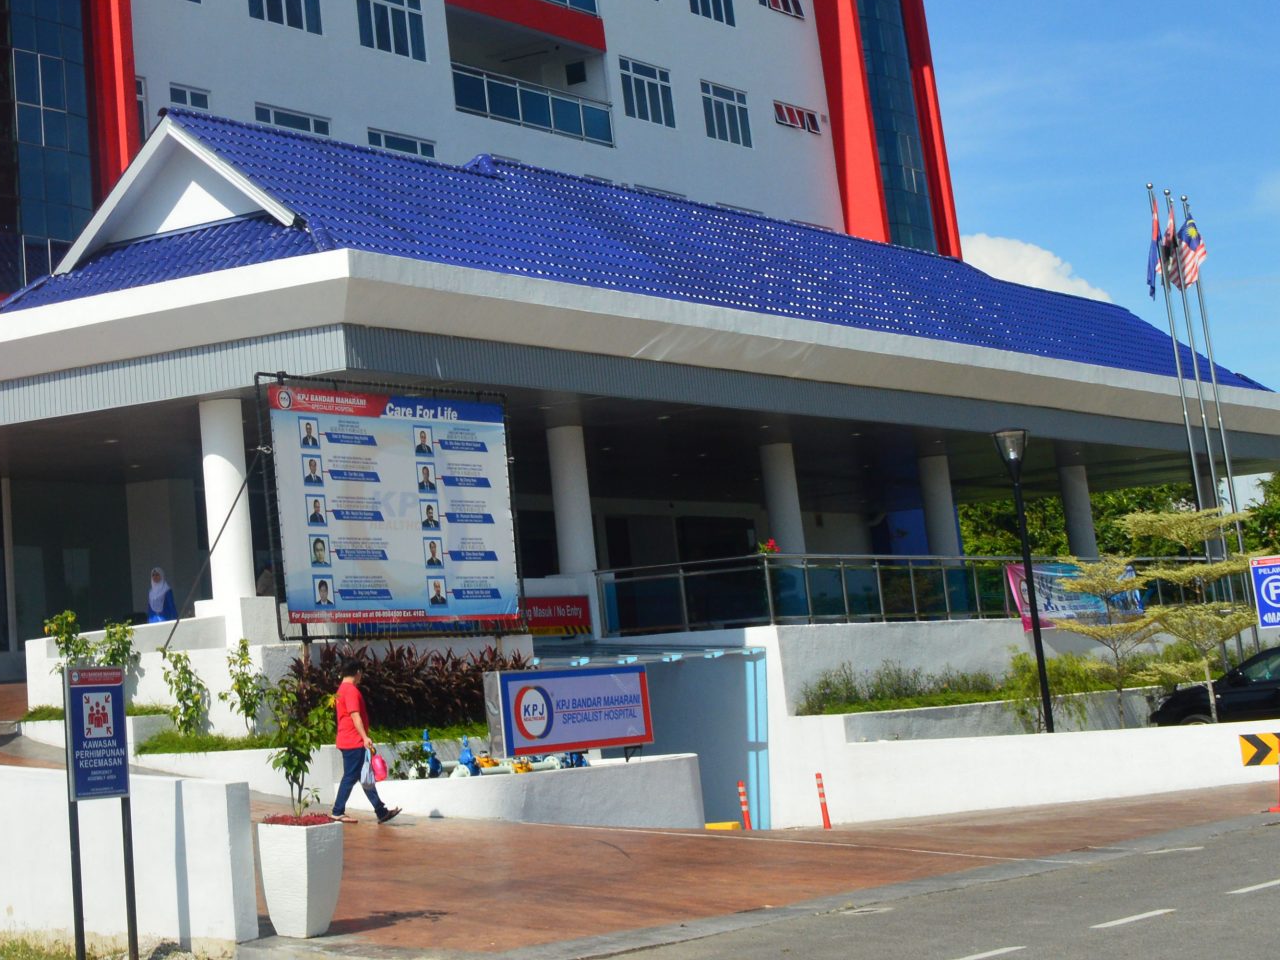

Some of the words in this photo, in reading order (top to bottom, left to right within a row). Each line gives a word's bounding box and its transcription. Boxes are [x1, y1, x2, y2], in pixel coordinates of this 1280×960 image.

[297, 393, 308, 401] KPJ
[310, 394, 336, 403] BANDAR
[336, 397, 367, 406] MAHARANI
[311, 403, 334, 411] SPECIALIST
[385, 402, 414, 418] Care
[416, 404, 435, 419] For
[437, 406, 458, 421] Life
[556, 699, 570, 710] KPJ
[571, 696, 602, 709] BANDAR
[603, 693, 641, 707] MAHARANI
[523, 703, 545, 717] KPJ
[562, 711, 602, 724] SPECIALIST
[604, 708, 637, 720] HOSPITAL
[82, 740, 117, 749] KAWASAN
[75, 748, 125, 759] PERHIMPUNAN
[79, 758, 122, 768] KECEMASAN
